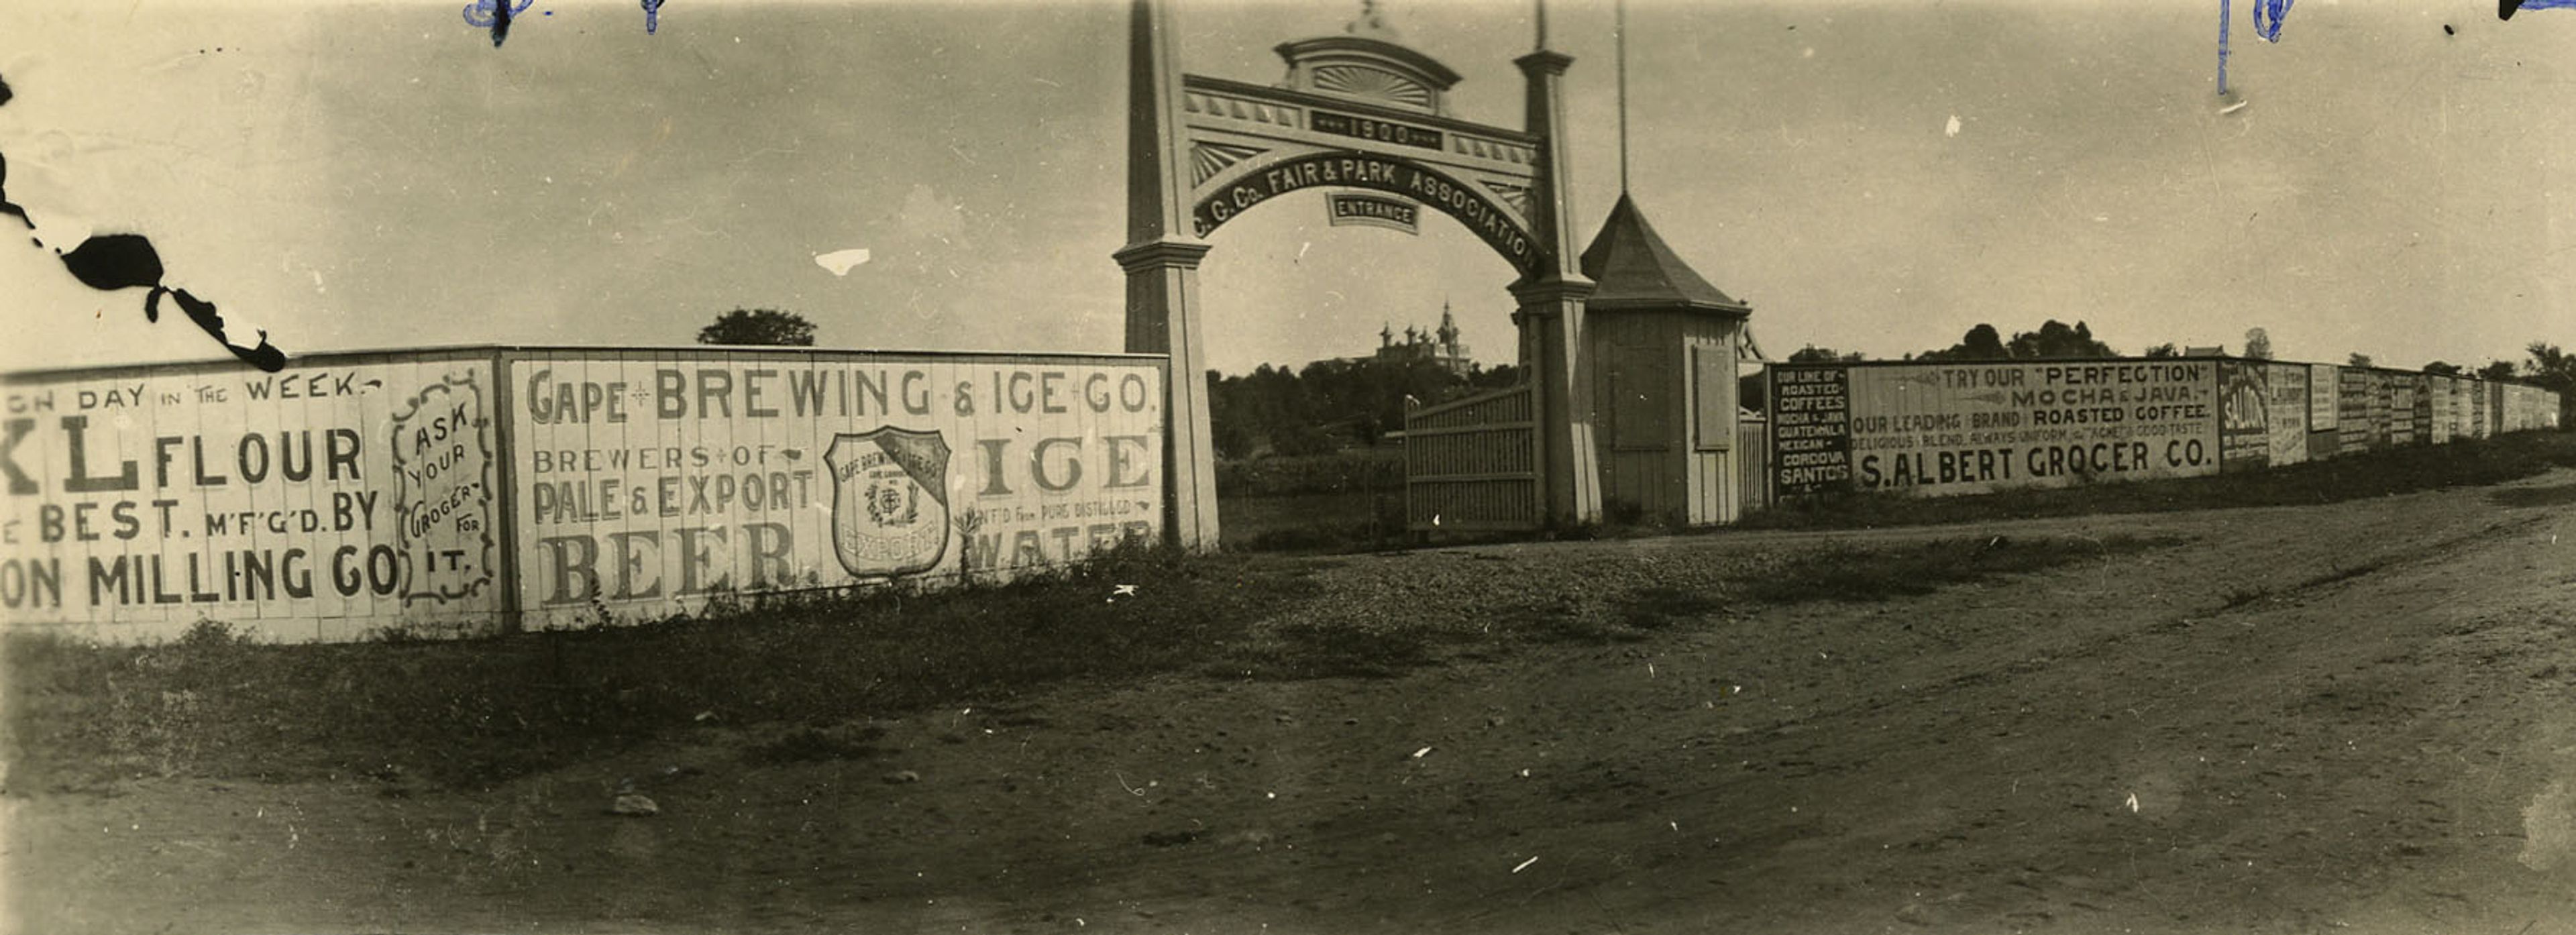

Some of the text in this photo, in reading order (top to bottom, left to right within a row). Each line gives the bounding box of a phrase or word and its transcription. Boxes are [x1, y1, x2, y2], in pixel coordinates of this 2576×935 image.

[1350, 117, 1407, 143] 1900
[1268, 162, 1319, 193] FAIR
[1323, 160, 1338, 180] &
[1342, 160, 1396, 184] PARK
[1410, 171, 1534, 267] ASSOCIATION
[1338, 201, 1413, 222] ENTRANCE
[1799, 371, 1821, 382] LINE
[1944, 368, 1978, 388] TRY
[1985, 368, 2025, 387] OUR
[79, 384, 145, 410] DAY
[161, 392, 181, 405] IN
[195, 385, 228, 403] THE
[655, 369, 930, 420] BREWING
[953, 381, 976, 417] &
[1780, 396, 1845, 412] COFFEES
[2012, 388, 2113, 407] MOCHA
[416, 403, 467, 455] ASK
[1853, 416, 1888, 434] OUR
[1893, 412, 1961, 432] LEADING
[1972, 411, 2020, 429] BRAND
[2034, 408, 2125, 426] ROASTED
[156, 428, 361, 488] FLOUR
[409, 445, 464, 488] YOUR
[533, 444, 775, 473] BREWERS OF
[1783, 450, 1845, 467] CORDOVA
[2027, 442, 2148, 477] GROCER
[1780, 464, 1848, 484] SANTOS
[533, 470, 813, 524] PALE & EXPORT
[40, 499, 190, 543] BEST.
[333, 491, 378, 532] BY
[457, 513, 480, 532] FOR
[89, 547, 314, 606] MILLING
